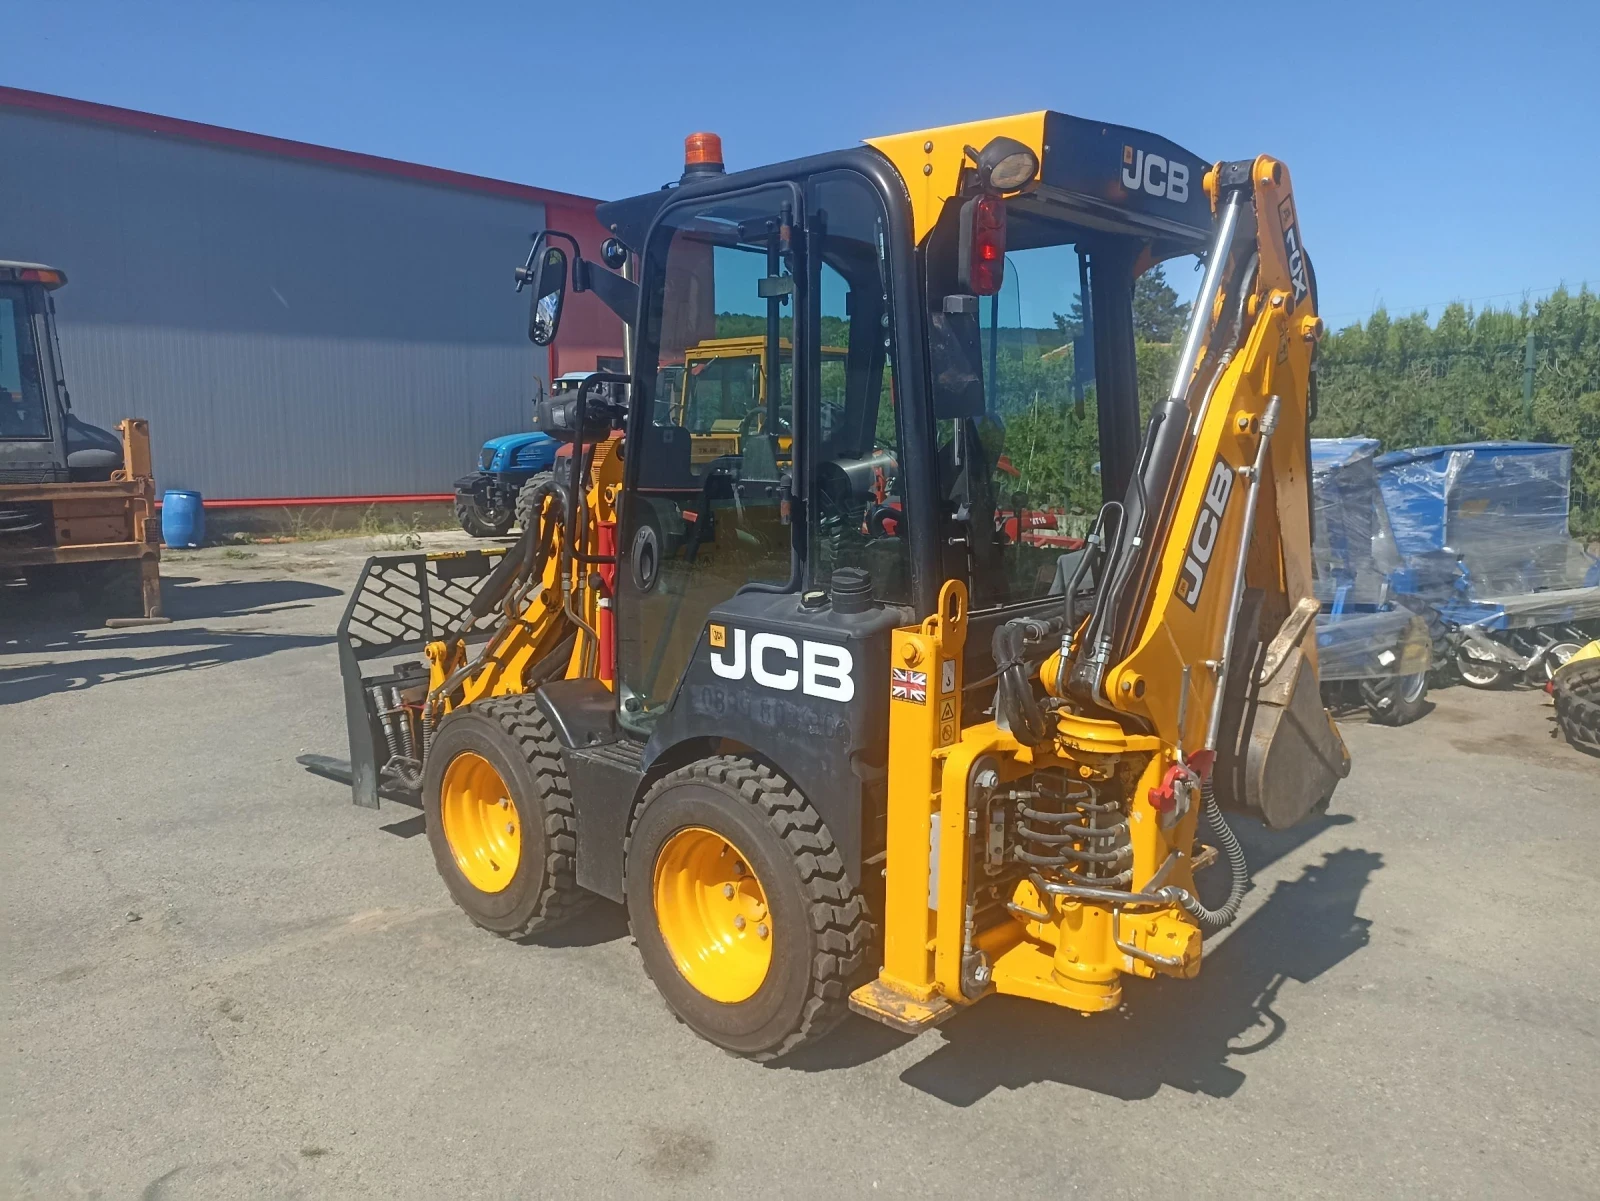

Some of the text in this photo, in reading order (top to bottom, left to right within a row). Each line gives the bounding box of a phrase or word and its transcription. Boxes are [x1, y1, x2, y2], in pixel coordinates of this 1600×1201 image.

[1122, 149, 1189, 204] JCB
[1286, 228, 1307, 300] 1CX
[1184, 461, 1233, 605] JCB
[710, 628, 855, 703] JCB
